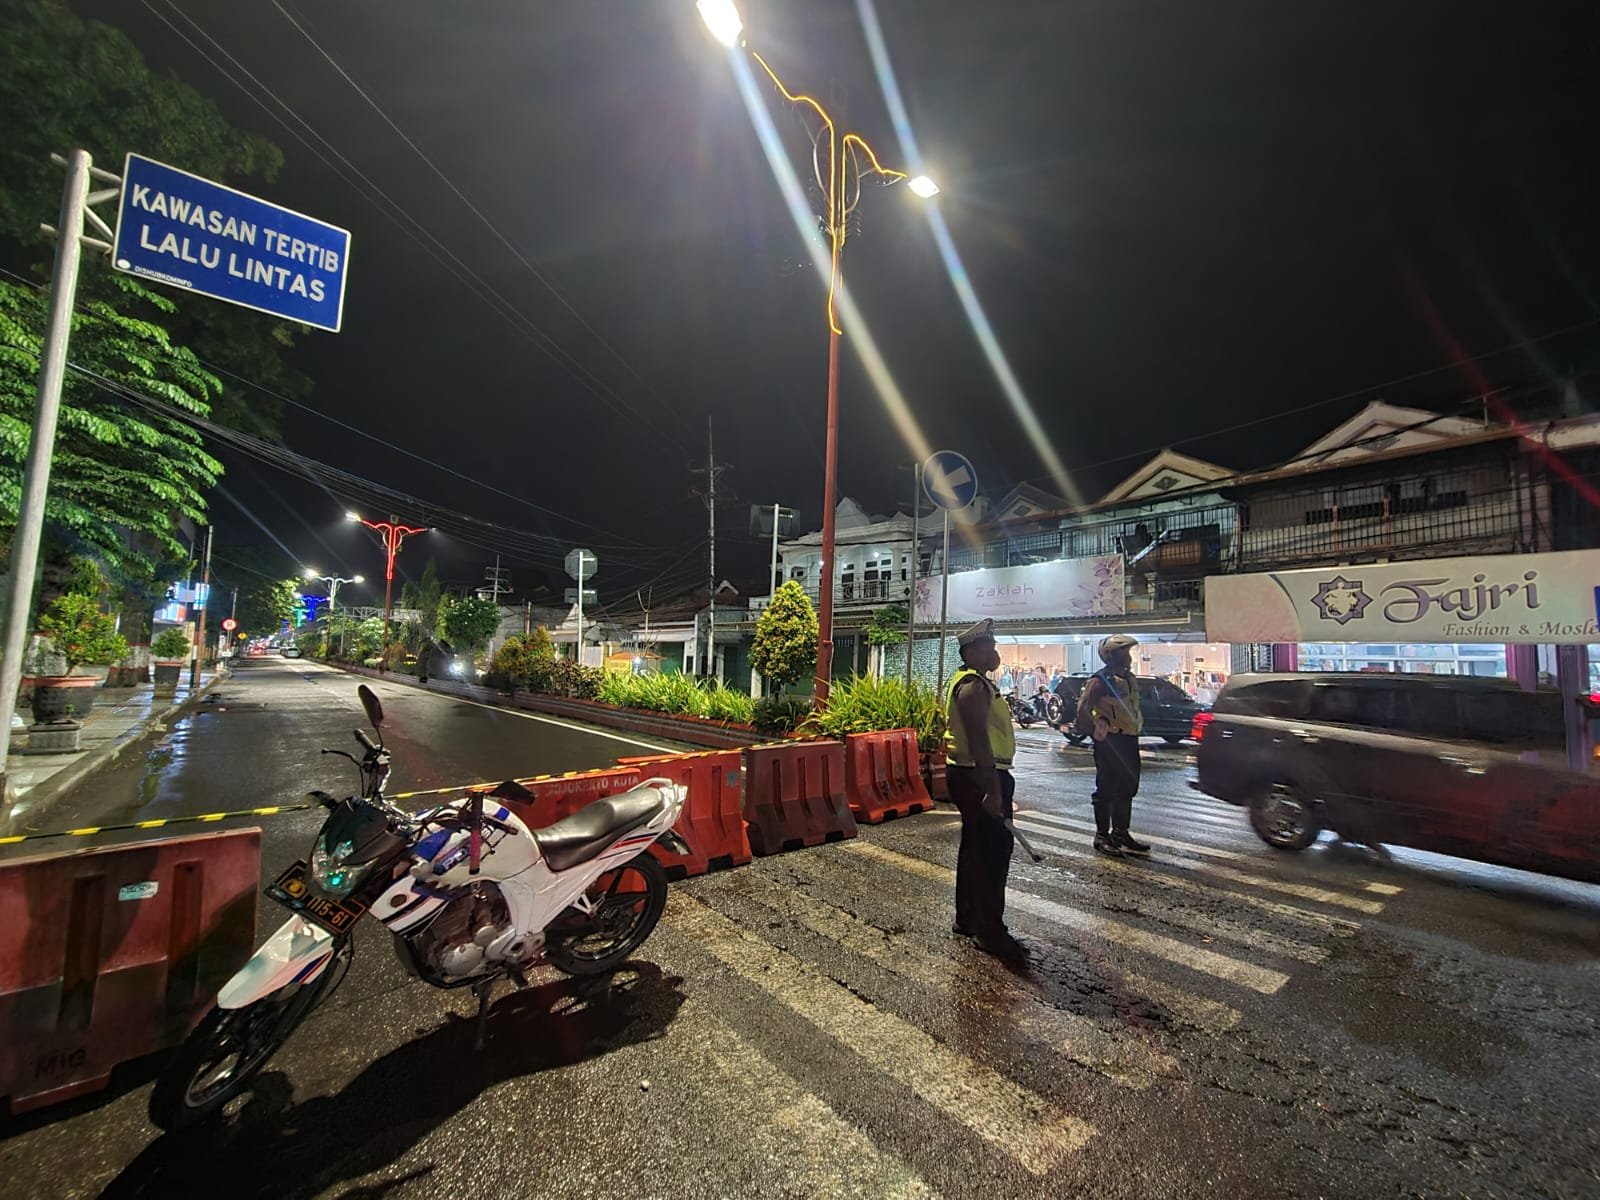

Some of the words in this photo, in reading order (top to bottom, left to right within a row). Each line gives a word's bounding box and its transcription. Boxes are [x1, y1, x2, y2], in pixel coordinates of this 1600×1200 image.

[131, 183, 256, 246] KAWASAN
[263, 228, 339, 273] TERTIB
[140, 224, 220, 269] LALU
[228, 253, 325, 303] LINTAS
[1379, 570, 1542, 624] Fajri
[1442, 621, 1510, 636] Fashion
[1518, 624, 1530, 635] &
